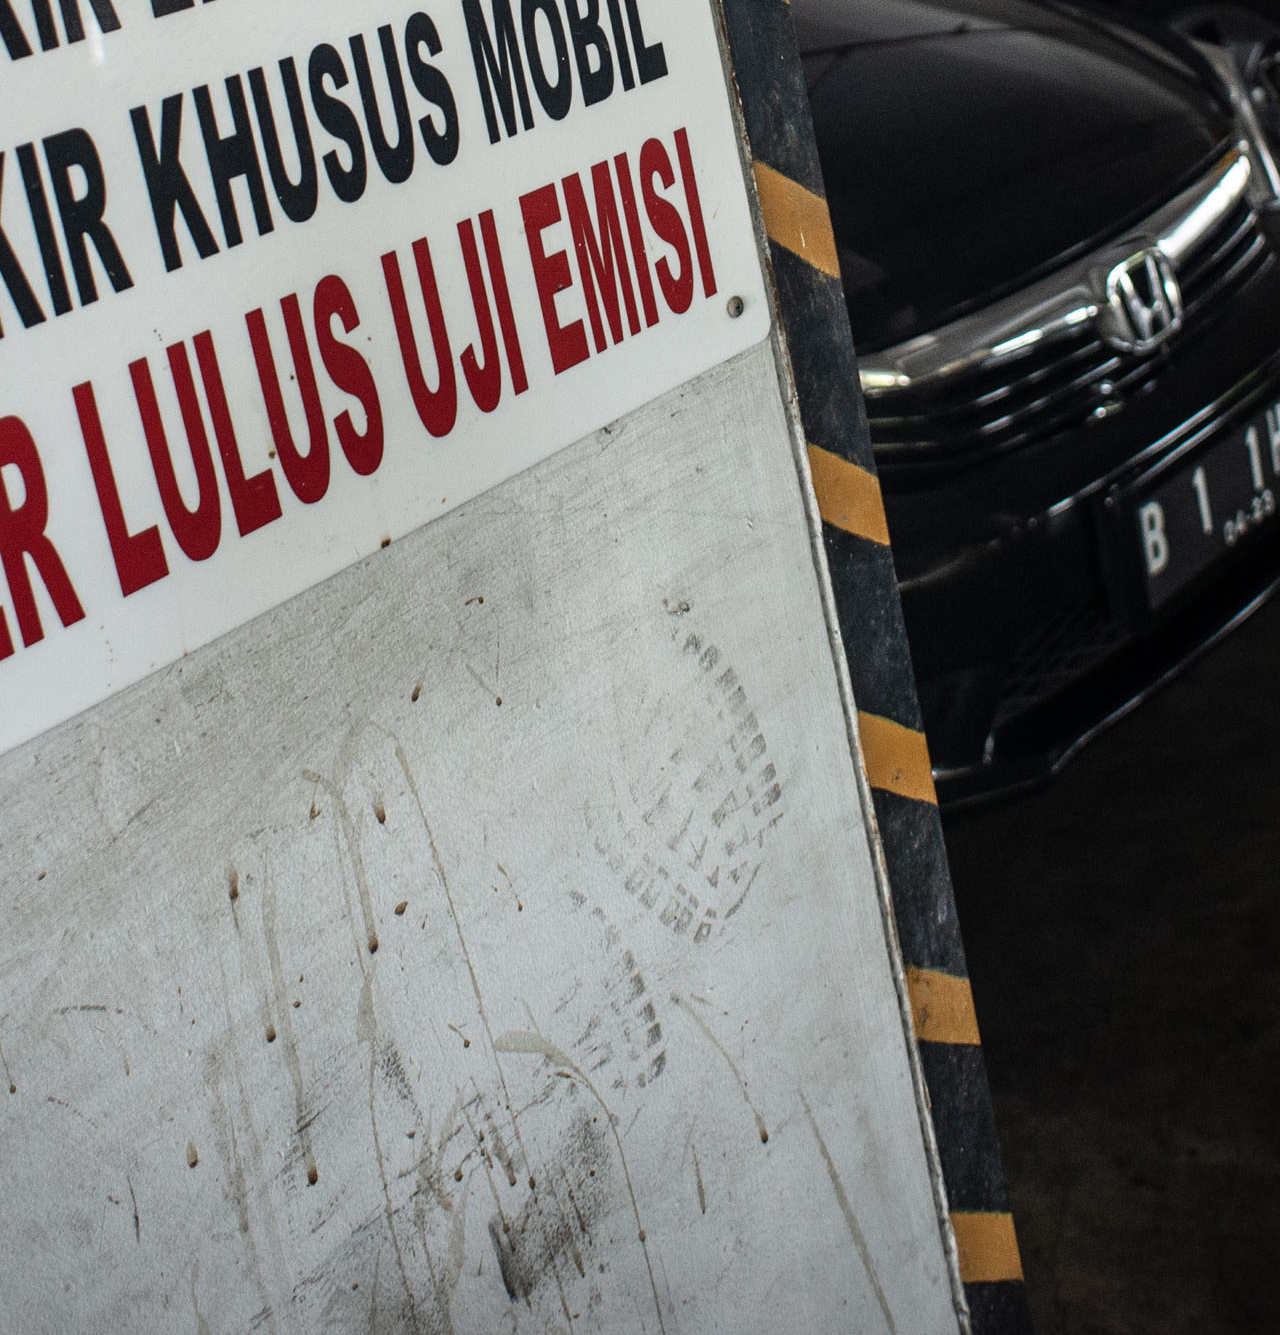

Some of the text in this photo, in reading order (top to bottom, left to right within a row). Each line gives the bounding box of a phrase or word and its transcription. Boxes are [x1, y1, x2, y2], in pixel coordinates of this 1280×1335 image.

[128, 11, 461, 274] KHUSUS
[70, 273, 385, 599] LULUS
[379, 208, 530, 439] UJI
[518, 126, 719, 377] EMISI
[1138, 501, 1170, 576] B
[1192, 466, 1214, 535] 1
